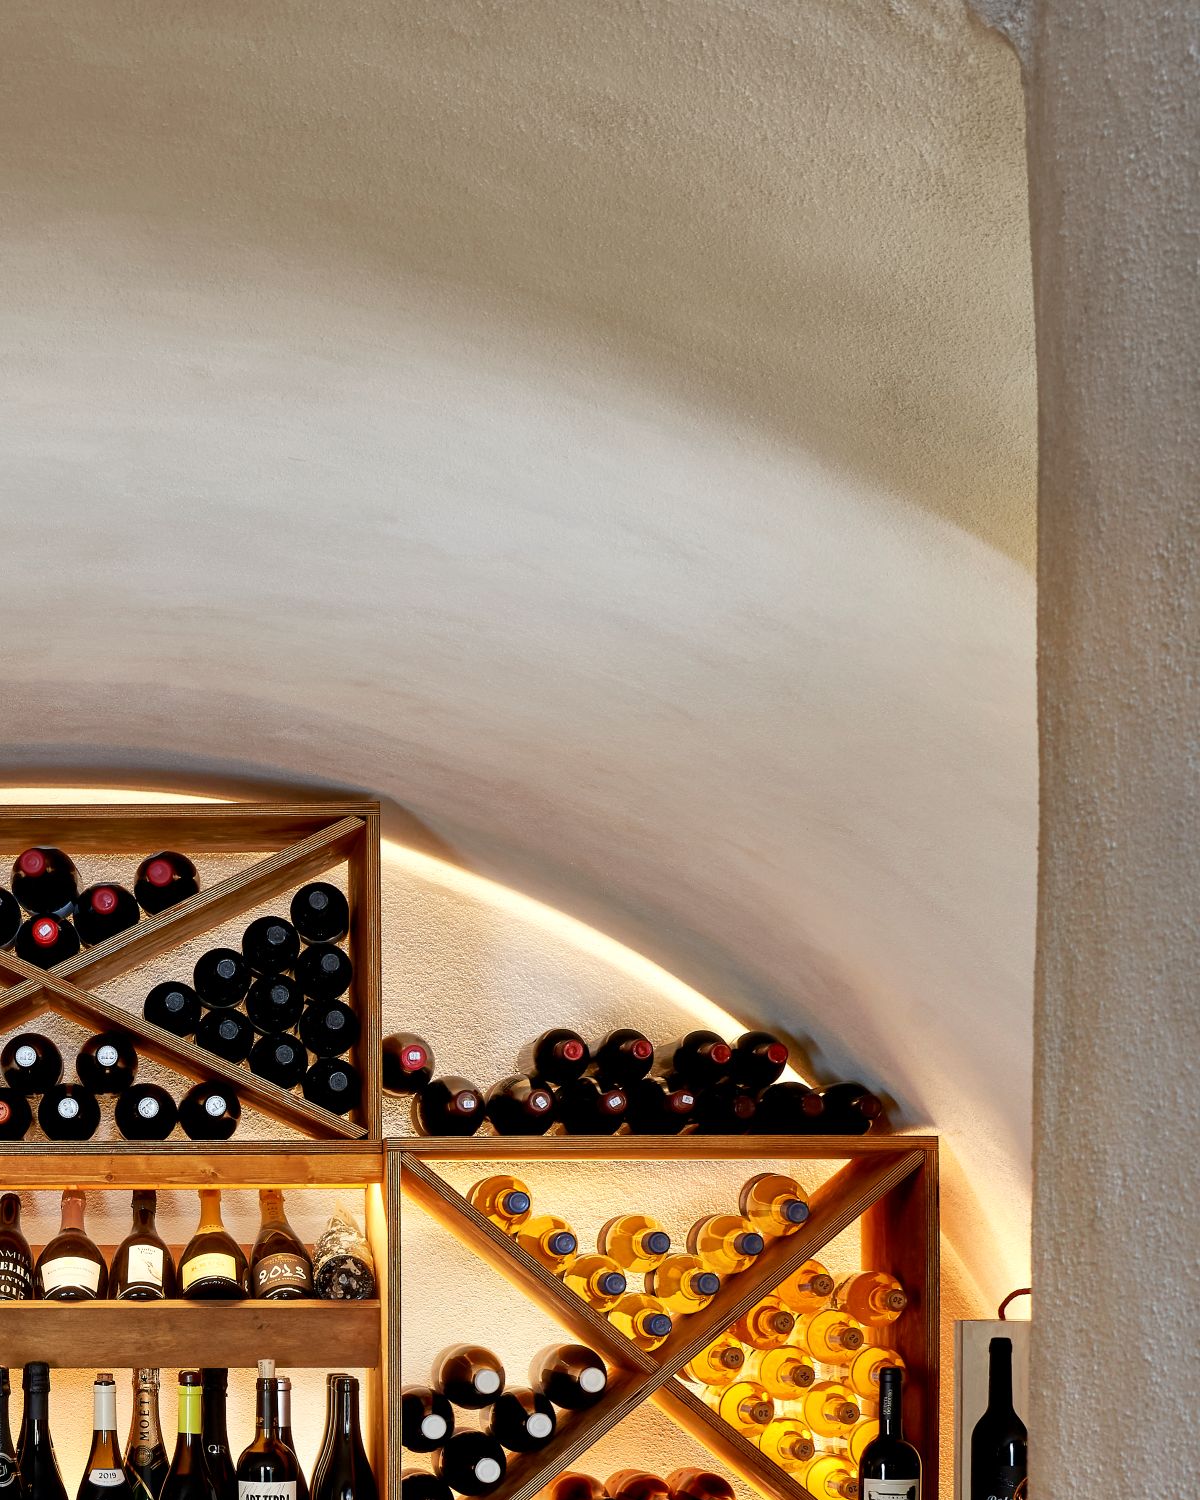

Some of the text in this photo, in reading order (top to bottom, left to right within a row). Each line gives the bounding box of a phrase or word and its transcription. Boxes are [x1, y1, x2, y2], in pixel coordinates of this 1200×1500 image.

[259, 1263, 307, 1286] 2013
[780, 1317, 789, 1327] 20
[850, 1334, 859, 1343] 20
[730, 1354, 740, 1362] 20
[800, 1372, 809, 1381] 20
[758, 1409, 769, 1417] 20
